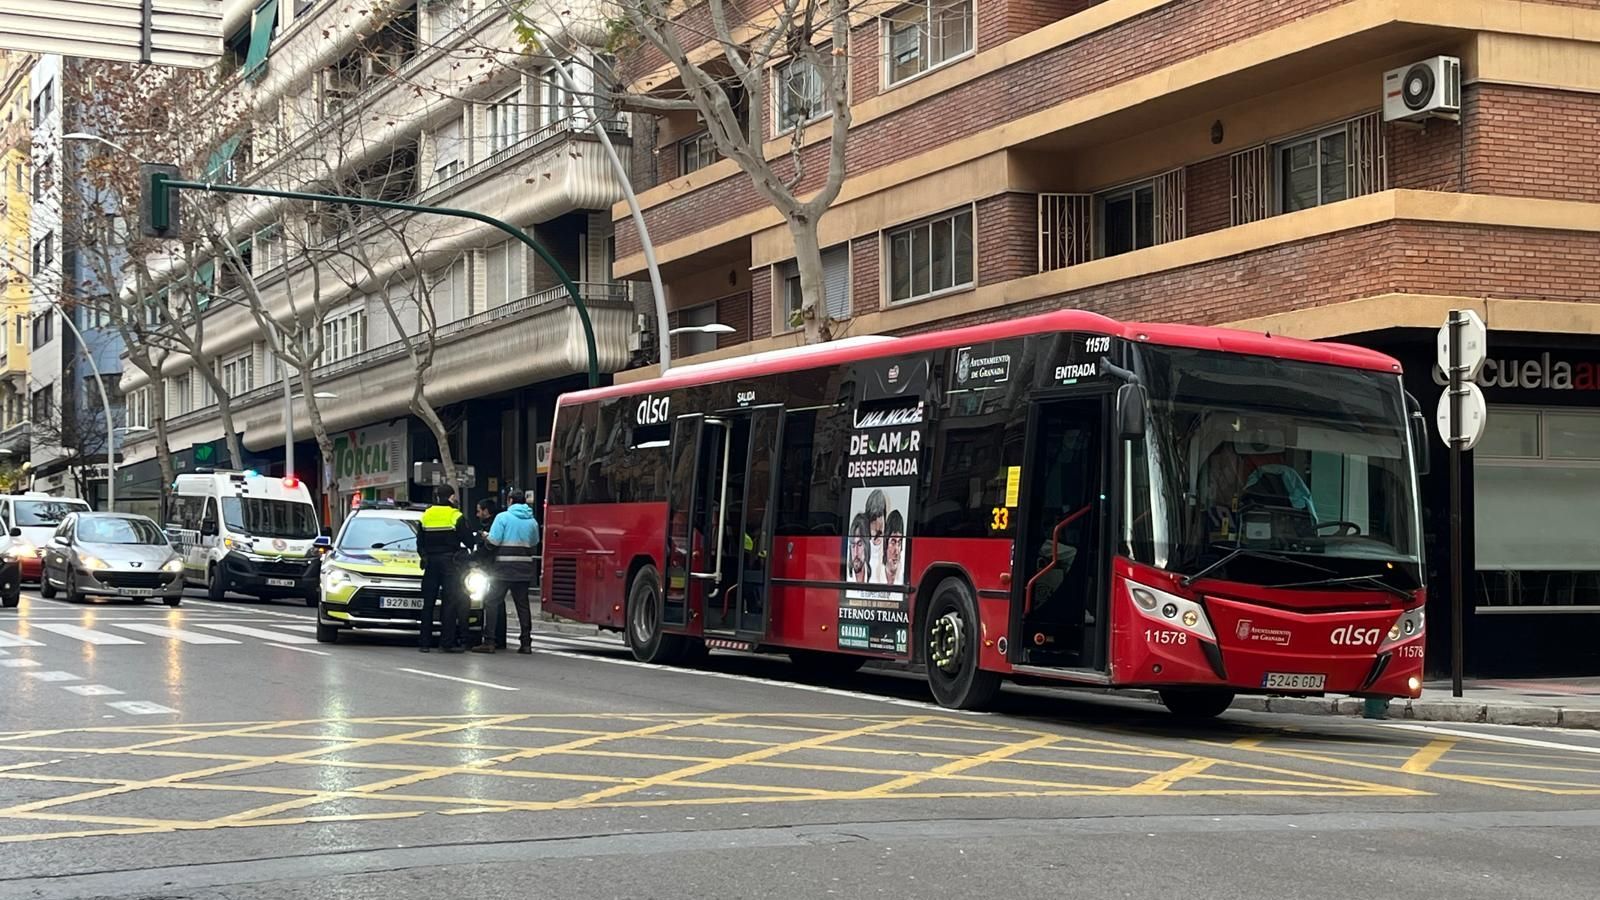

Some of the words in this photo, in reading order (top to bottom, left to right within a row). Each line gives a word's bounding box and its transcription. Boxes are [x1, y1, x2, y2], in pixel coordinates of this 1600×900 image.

[1086, 337, 1110, 352] 11578
[1055, 363, 1096, 379] ENTRADA
[1432, 352, 1600, 389] cuelaa
[737, 391, 755, 403] SALIDA
[637, 395, 670, 424] alsa
[850, 434, 869, 456] DE
[334, 436, 389, 479] TORCAL
[847, 458, 918, 478] DESESPERADA
[991, 507, 1008, 530] 33
[386, 598, 409, 608] 9276
[410, 599, 423, 608] NG
[839, 607, 875, 621] ETERNOS
[876, 610, 909, 623] TRIANA
[896, 629, 907, 643] 10
[1144, 630, 1187, 645] 11578
[1330, 624, 1380, 646] alsa
[1398, 646, 1424, 658] 11578
[1268, 674, 1301, 688] 5246
[1301, 676, 1323, 689] GDJ
